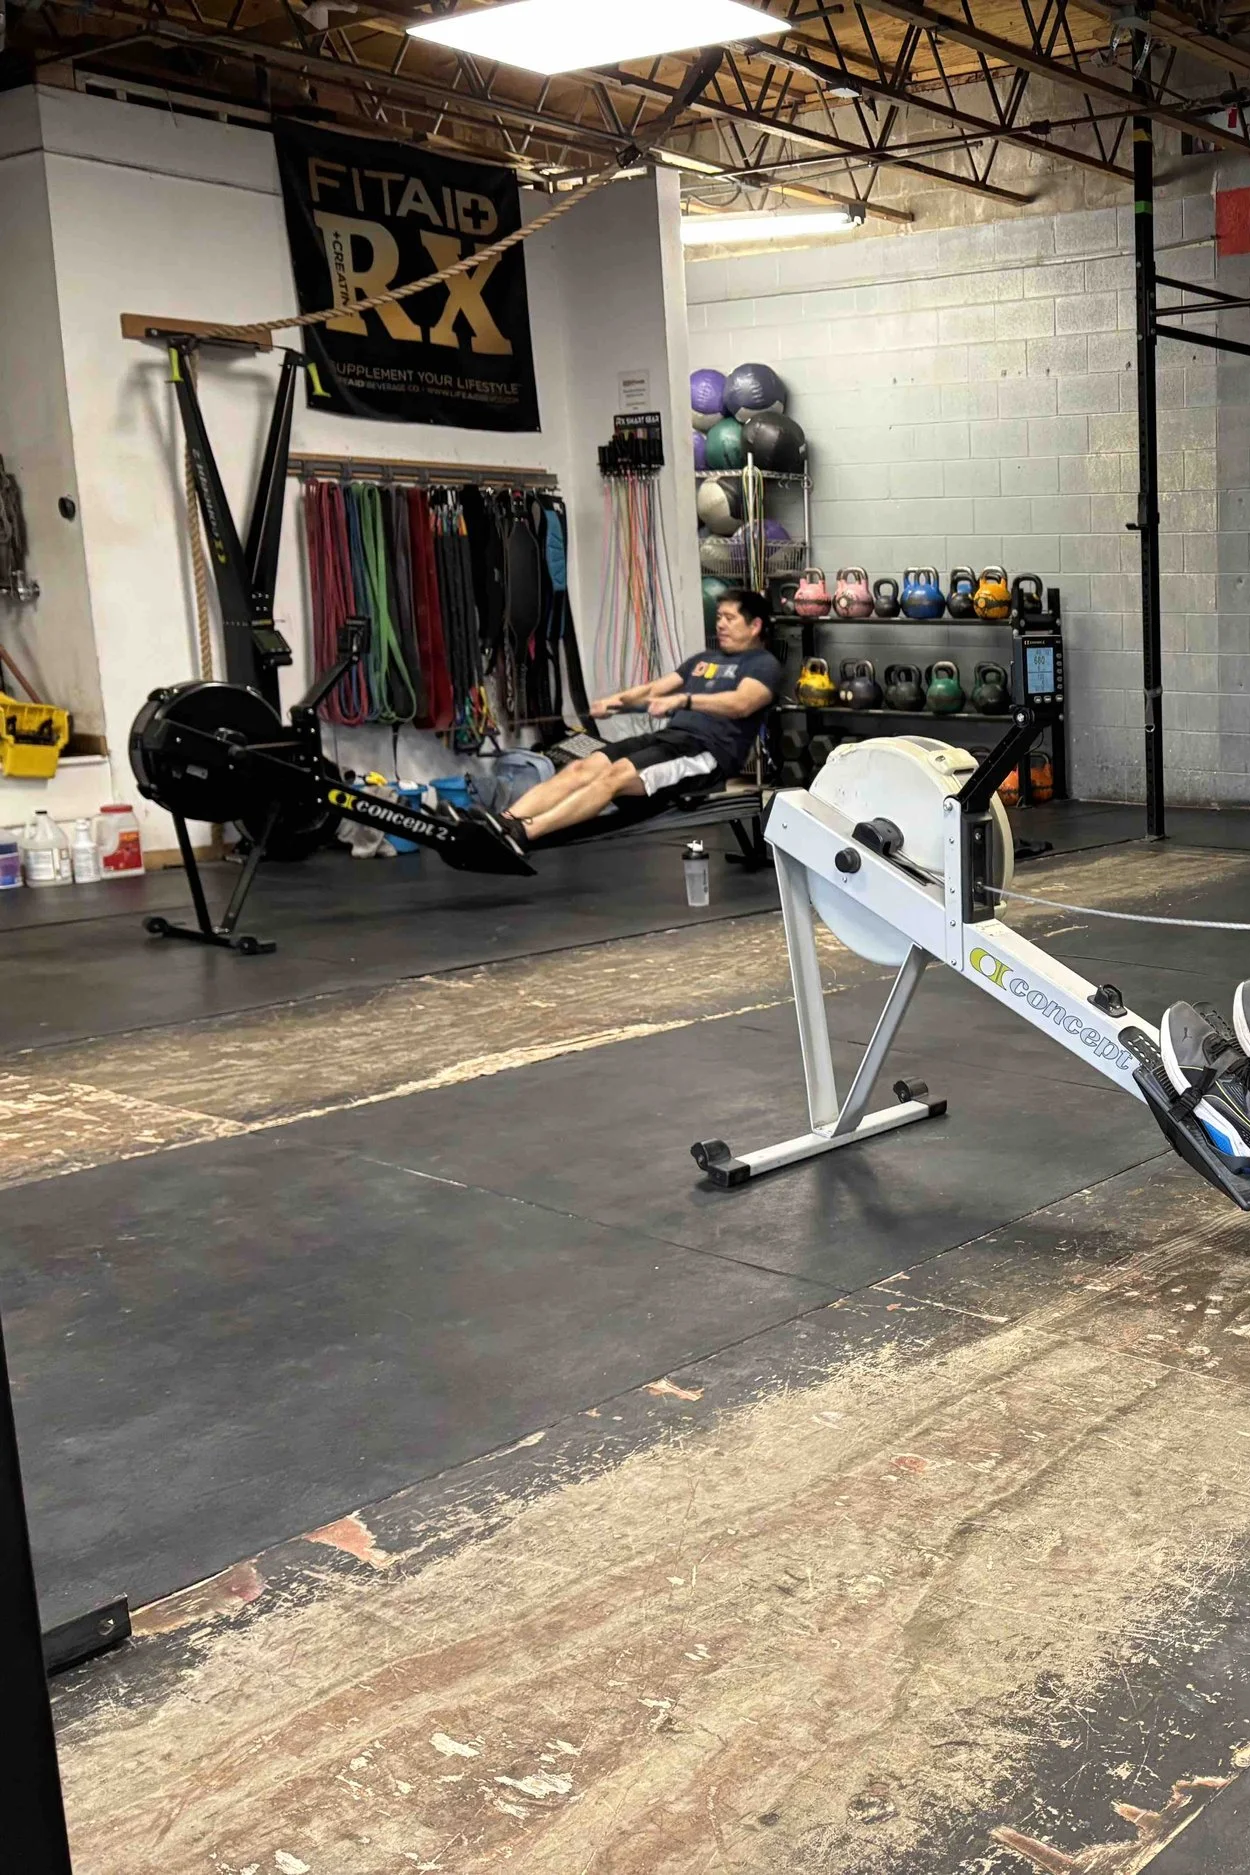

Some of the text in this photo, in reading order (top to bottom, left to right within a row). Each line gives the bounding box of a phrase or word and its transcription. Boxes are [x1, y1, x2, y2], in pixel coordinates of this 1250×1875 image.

[308, 157, 499, 237] FITAID
[313, 209, 513, 355] RX
[417, 371, 453, 388] YOUR
[457, 377, 519, 395] LIFESTYLE
[356, 799, 449, 841] concept 2
[1009, 977, 1134, 1071] concept
